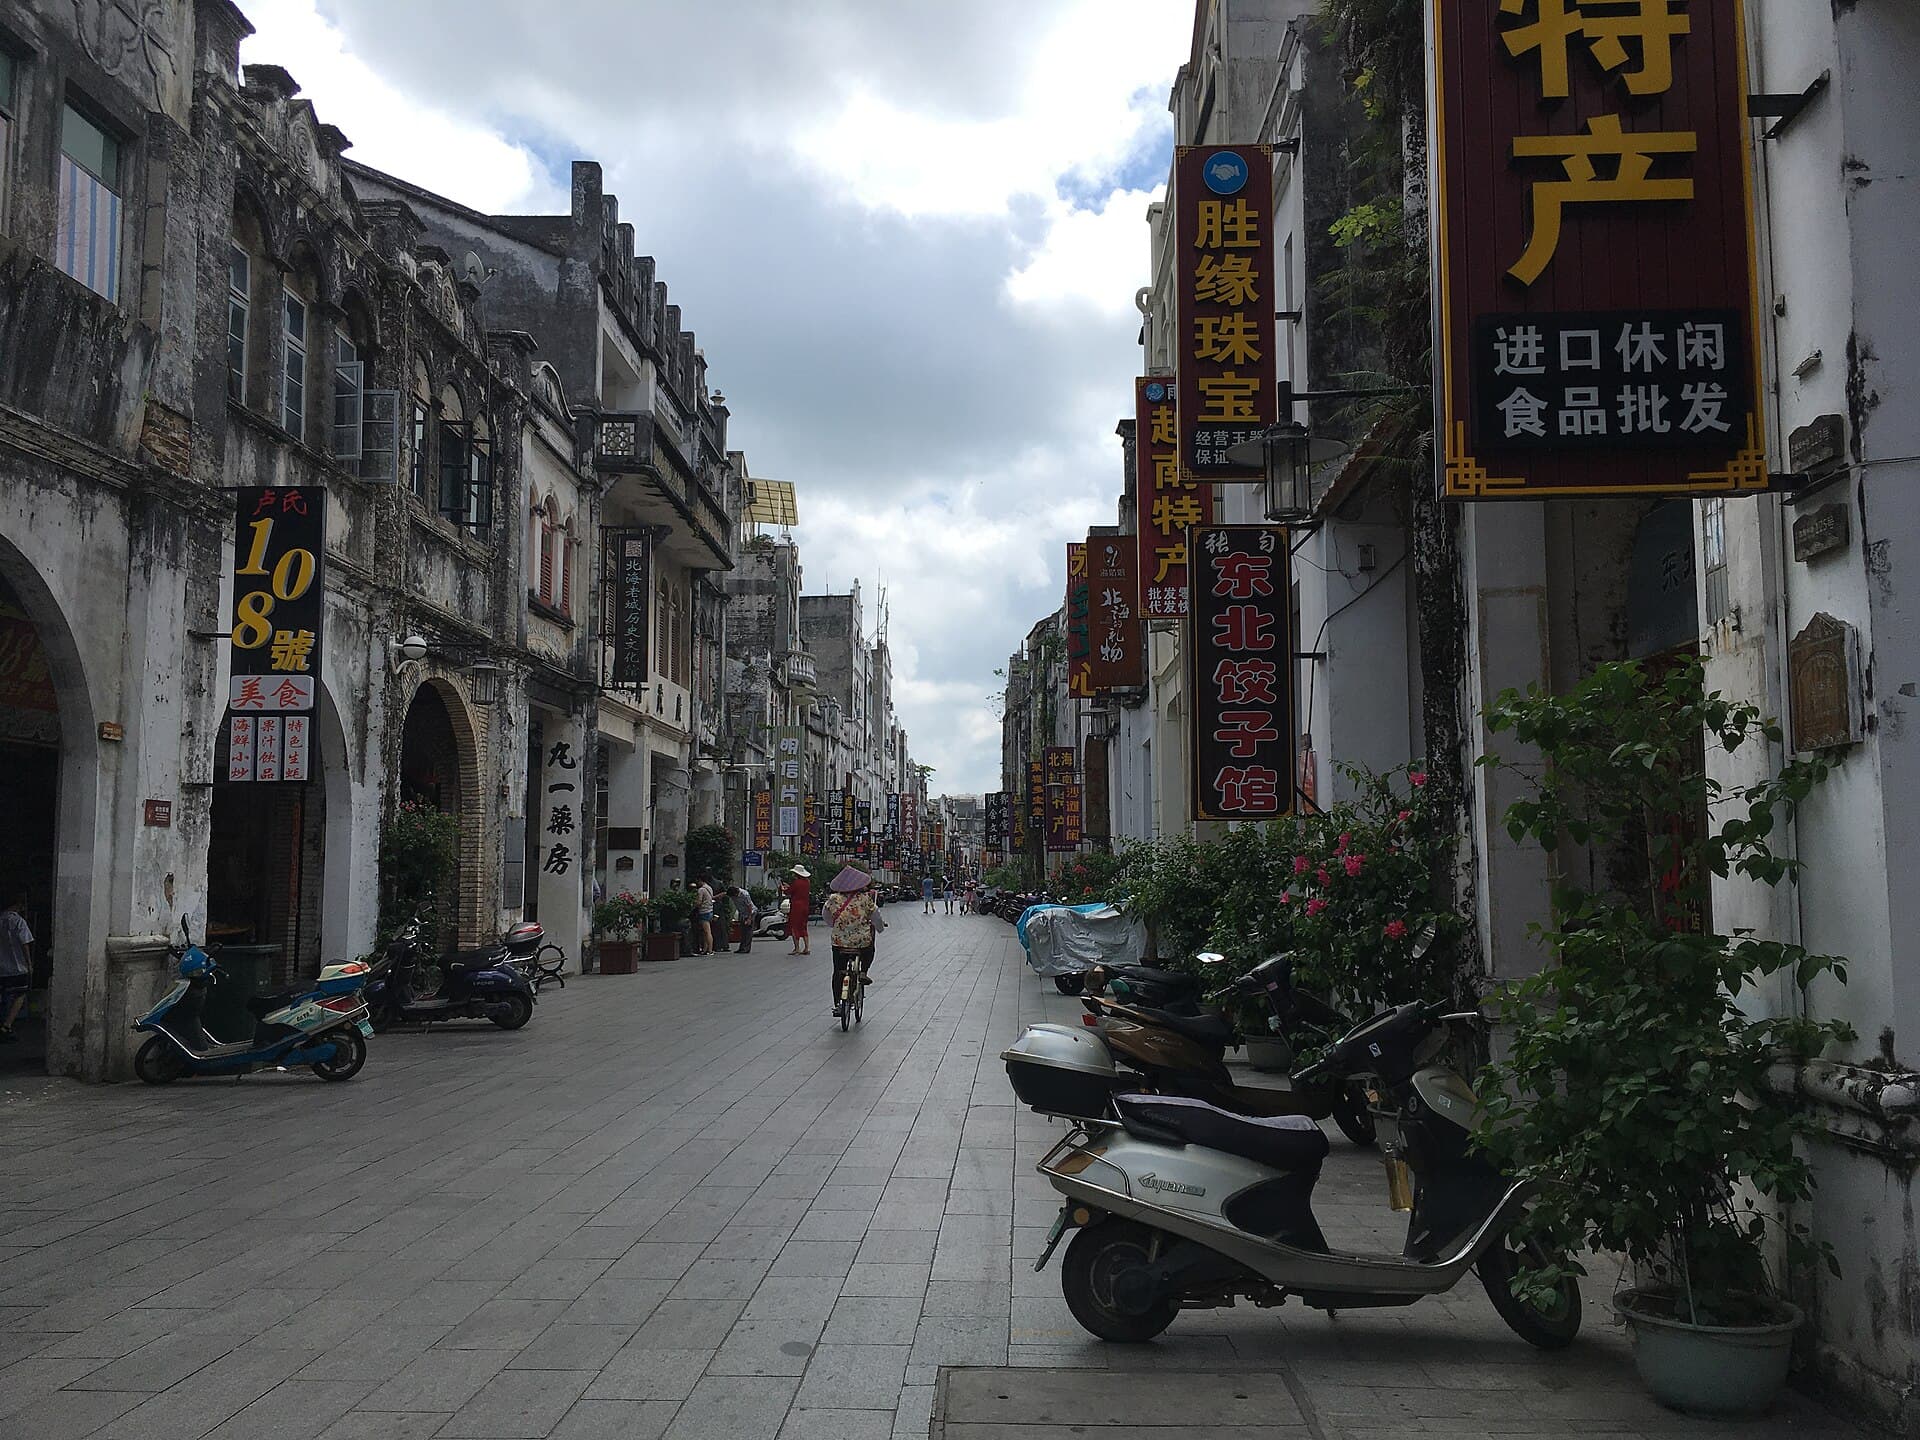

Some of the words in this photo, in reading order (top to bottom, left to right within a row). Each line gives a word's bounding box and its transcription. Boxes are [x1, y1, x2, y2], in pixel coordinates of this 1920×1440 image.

[1500, 0, 1698, 287] 特产
[1193, 198, 1263, 424] 胜缘珠宝
[1493, 321, 1727, 376] 进口休闲
[1496, 381, 1732, 438] 食品批发
[231, 678, 309, 708] 美食
[1211, 550, 1280, 813] 东北饺子馆
[230, 718, 251, 777] 海鲜小炒
[259, 719, 277, 780] 果汁饮品
[285, 719, 303, 779] 特色生蚝
[780, 738, 799, 803] 明信片
[1048, 752, 1073, 767] 北海
[755, 791, 772, 850] 银匠世家
[829, 791, 843, 845] 越南红木
